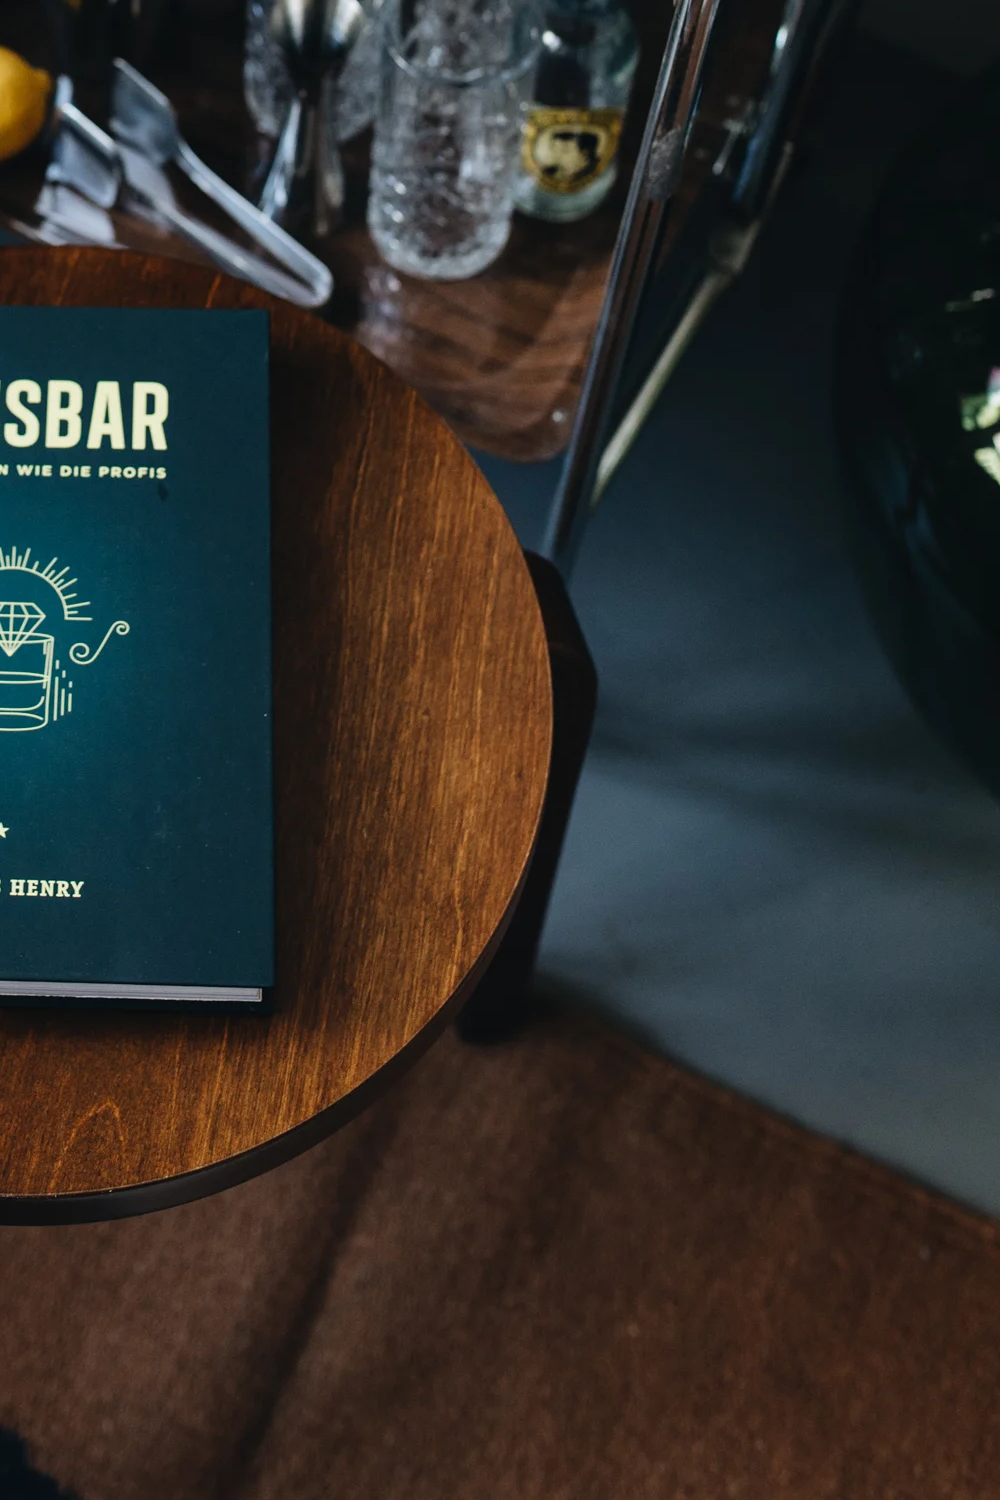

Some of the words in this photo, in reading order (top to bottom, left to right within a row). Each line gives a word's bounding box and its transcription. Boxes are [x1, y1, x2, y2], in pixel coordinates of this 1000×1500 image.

[16, 464, 53, 477] WIE
[59, 465, 92, 478] DIE
[98, 466, 167, 480] PROFIS
[9, 878, 85, 898] HENRY
